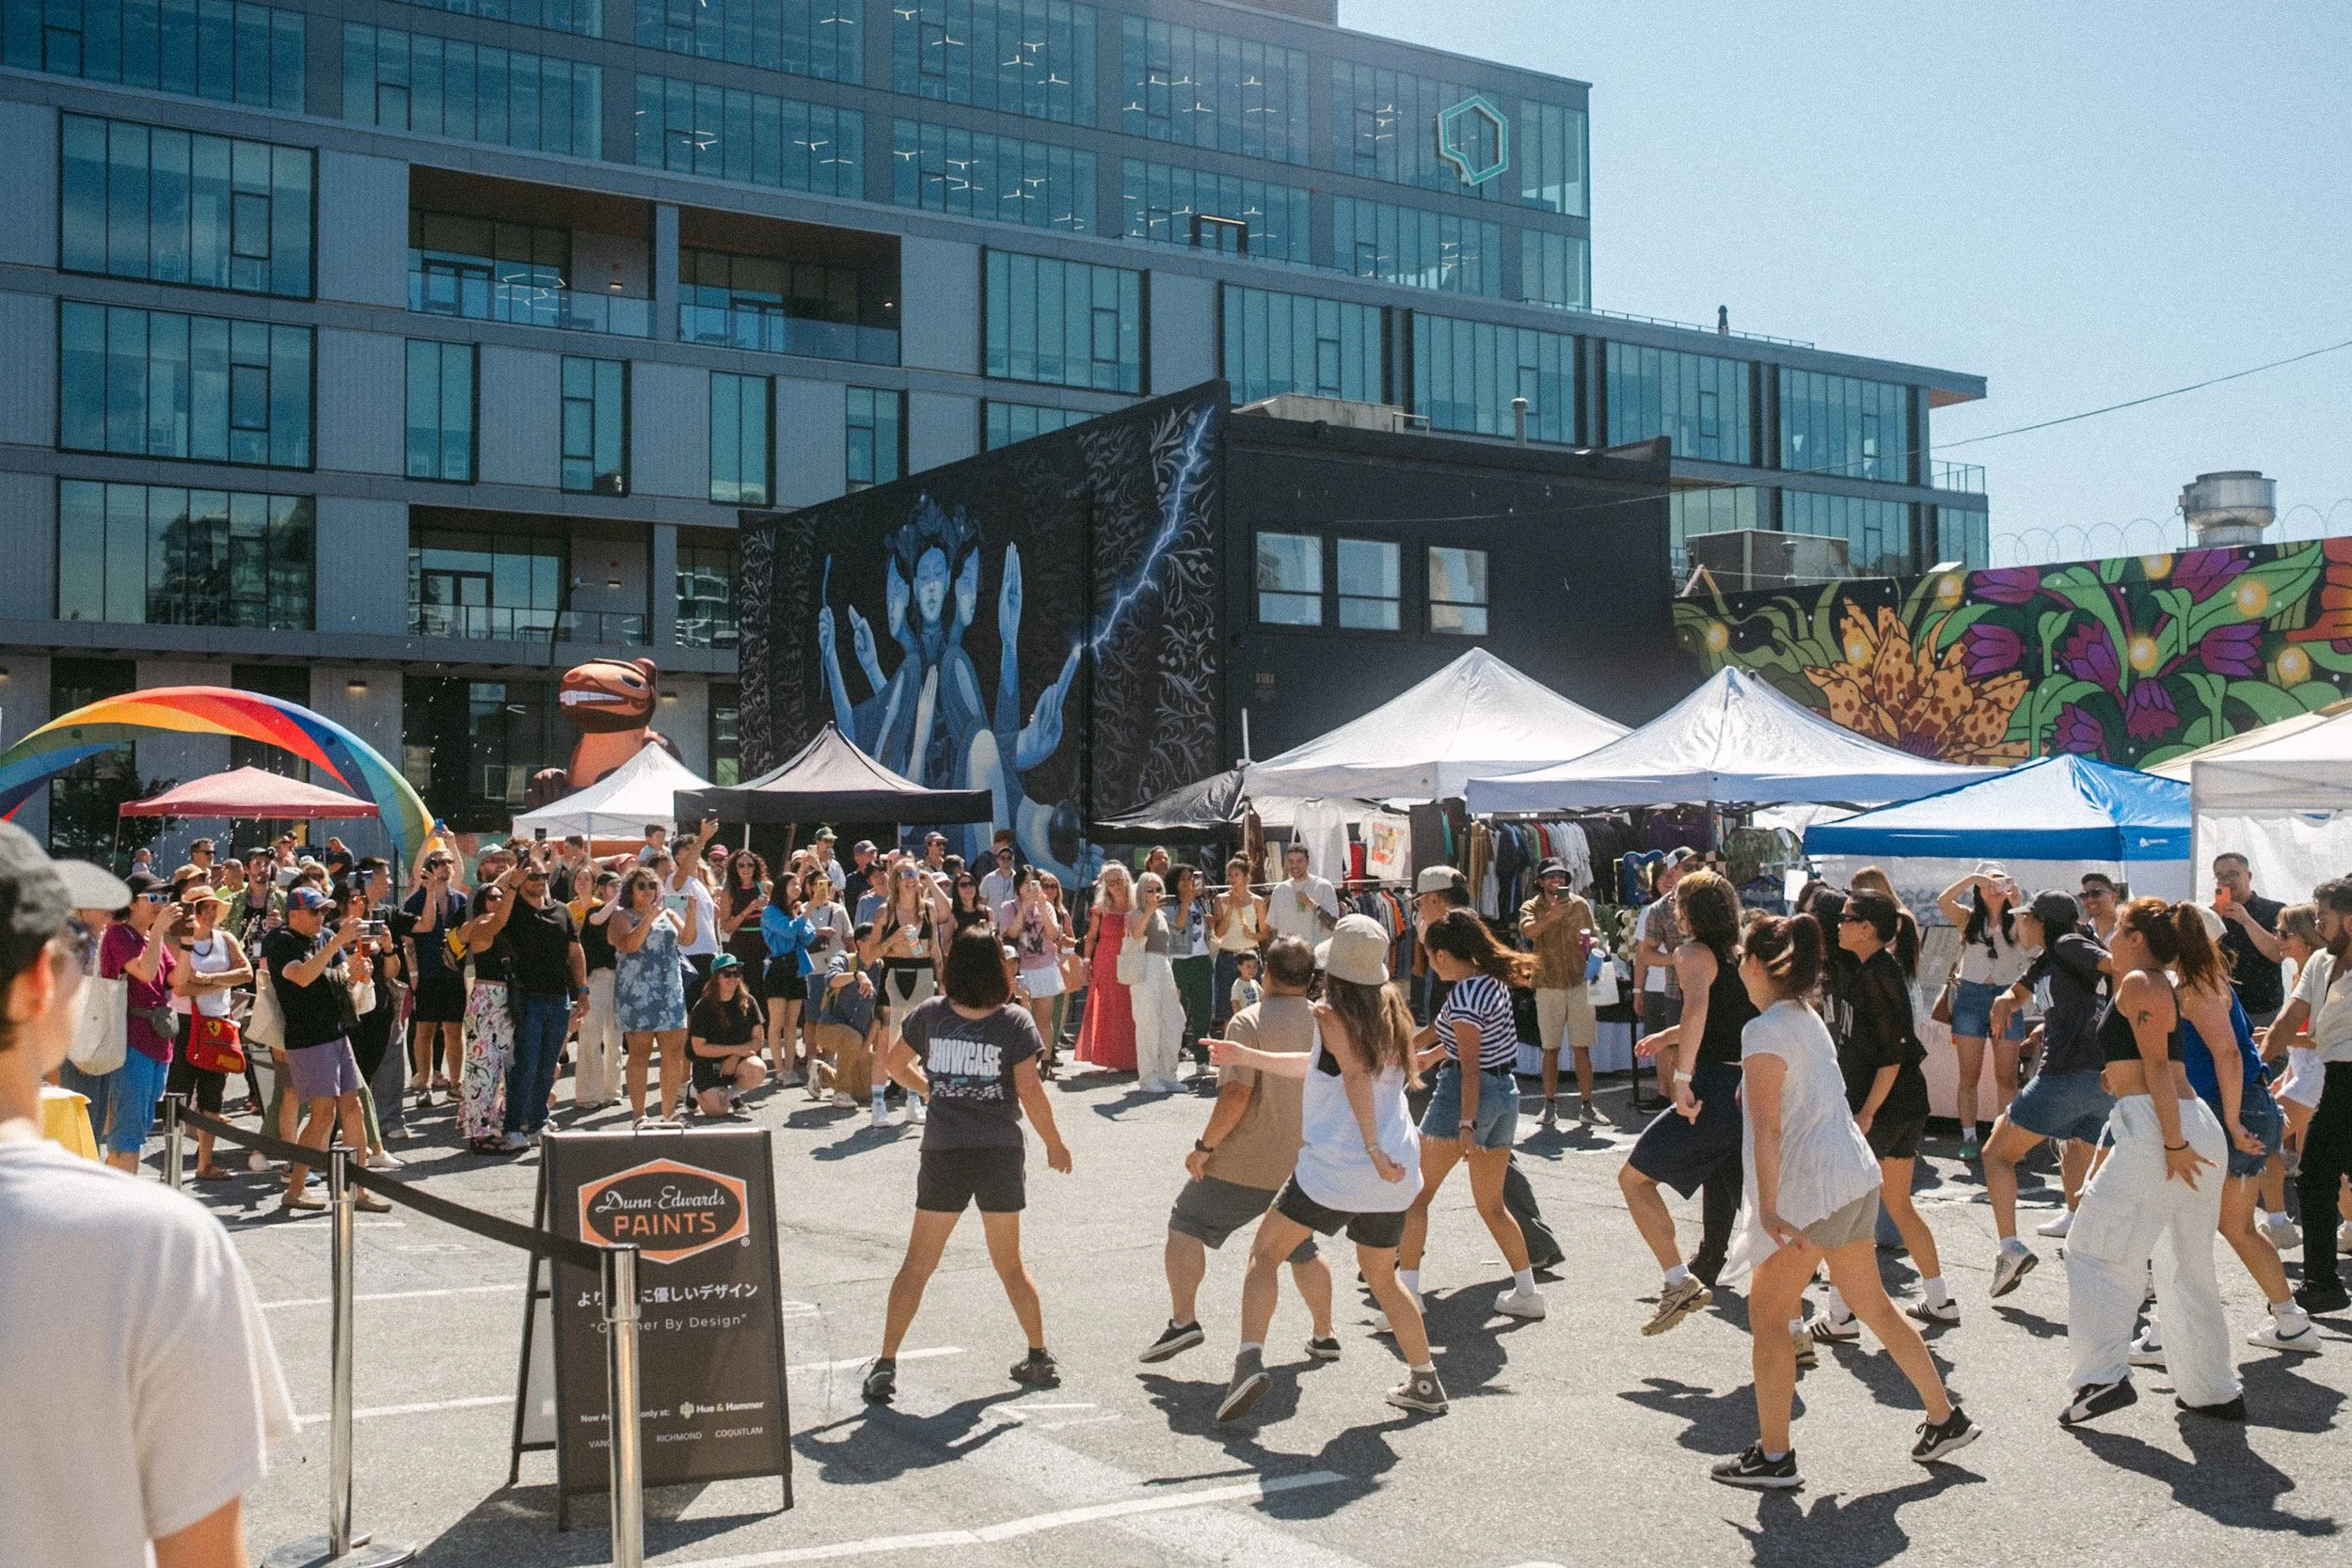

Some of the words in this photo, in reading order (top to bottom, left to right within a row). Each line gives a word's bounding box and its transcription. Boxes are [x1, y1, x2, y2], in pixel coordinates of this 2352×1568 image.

[595, 1185, 726, 1213] Dunn-Edwards
[614, 1212, 717, 1237] PAINTS
[578, 1283, 758, 1307] よりに優しいデザイン
[665, 1318, 683, 1331] By
[696, 1404, 715, 1414] Hue
[716, 1402, 724, 1412] &
[725, 1402, 764, 1411] Hammer
[580, 1414, 599, 1423] Now
[640, 1410, 658, 1419] only
[656, 1432, 702, 1443] RICHMOND
[715, 1427, 763, 1438] COQUITLAM
